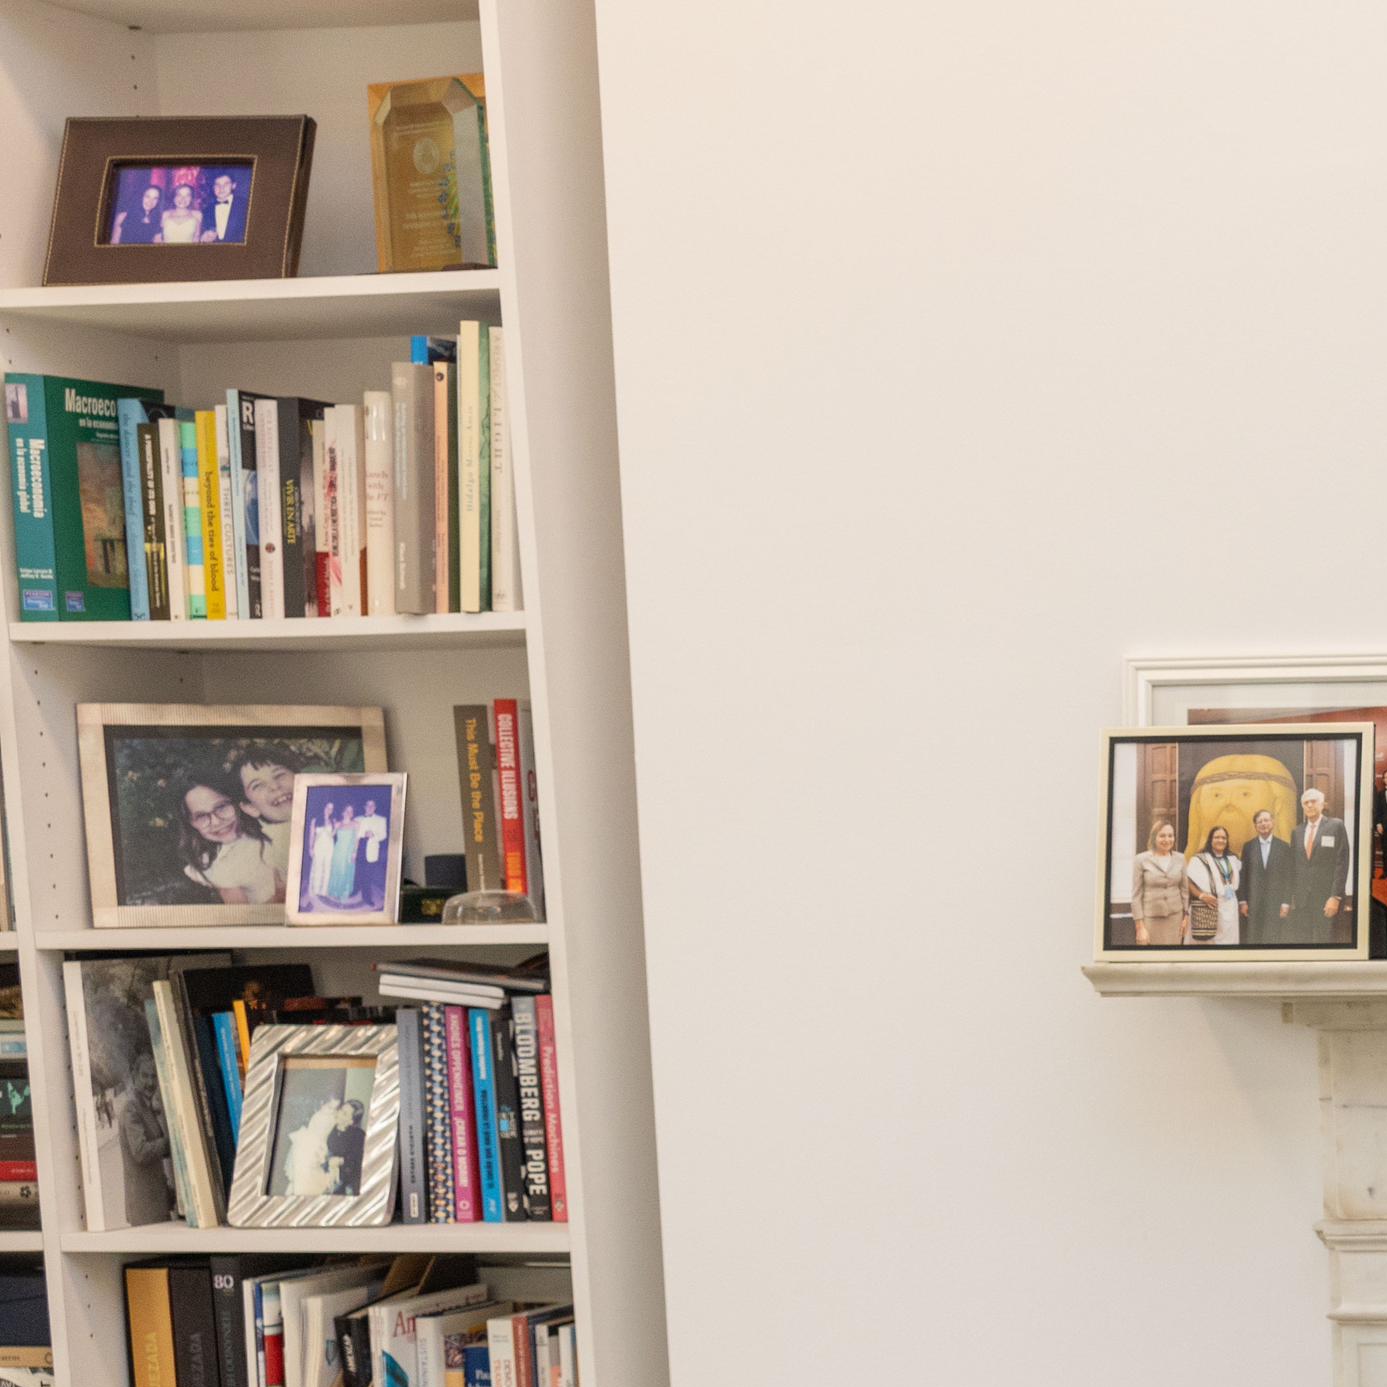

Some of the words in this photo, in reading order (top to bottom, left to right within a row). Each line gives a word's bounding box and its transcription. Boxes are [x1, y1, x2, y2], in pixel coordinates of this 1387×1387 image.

[204, 471, 216, 508] beyond
[208, 511, 216, 527] the
[210, 552, 218, 561] of
[210, 563, 219, 592] blood
[465, 719, 477, 741] This
[497, 713, 516, 769] COLLECTIVE
[467, 743, 480, 772] Must
[469, 772, 481, 789] Be
[501, 770, 519, 820] ILLUSIONS
[471, 791, 481, 810] the
[471, 812, 485, 844] Place
[451, 1049, 465, 1112] OPPENHEIMER
[513, 1012, 541, 1122] BLOOMBERG
[541, 1046, 554, 1110] Prediction
[546, 1113, 559, 1174] Machines
[526, 1149, 548, 1197] POPE
[213, 1274, 234, 1289] 80
